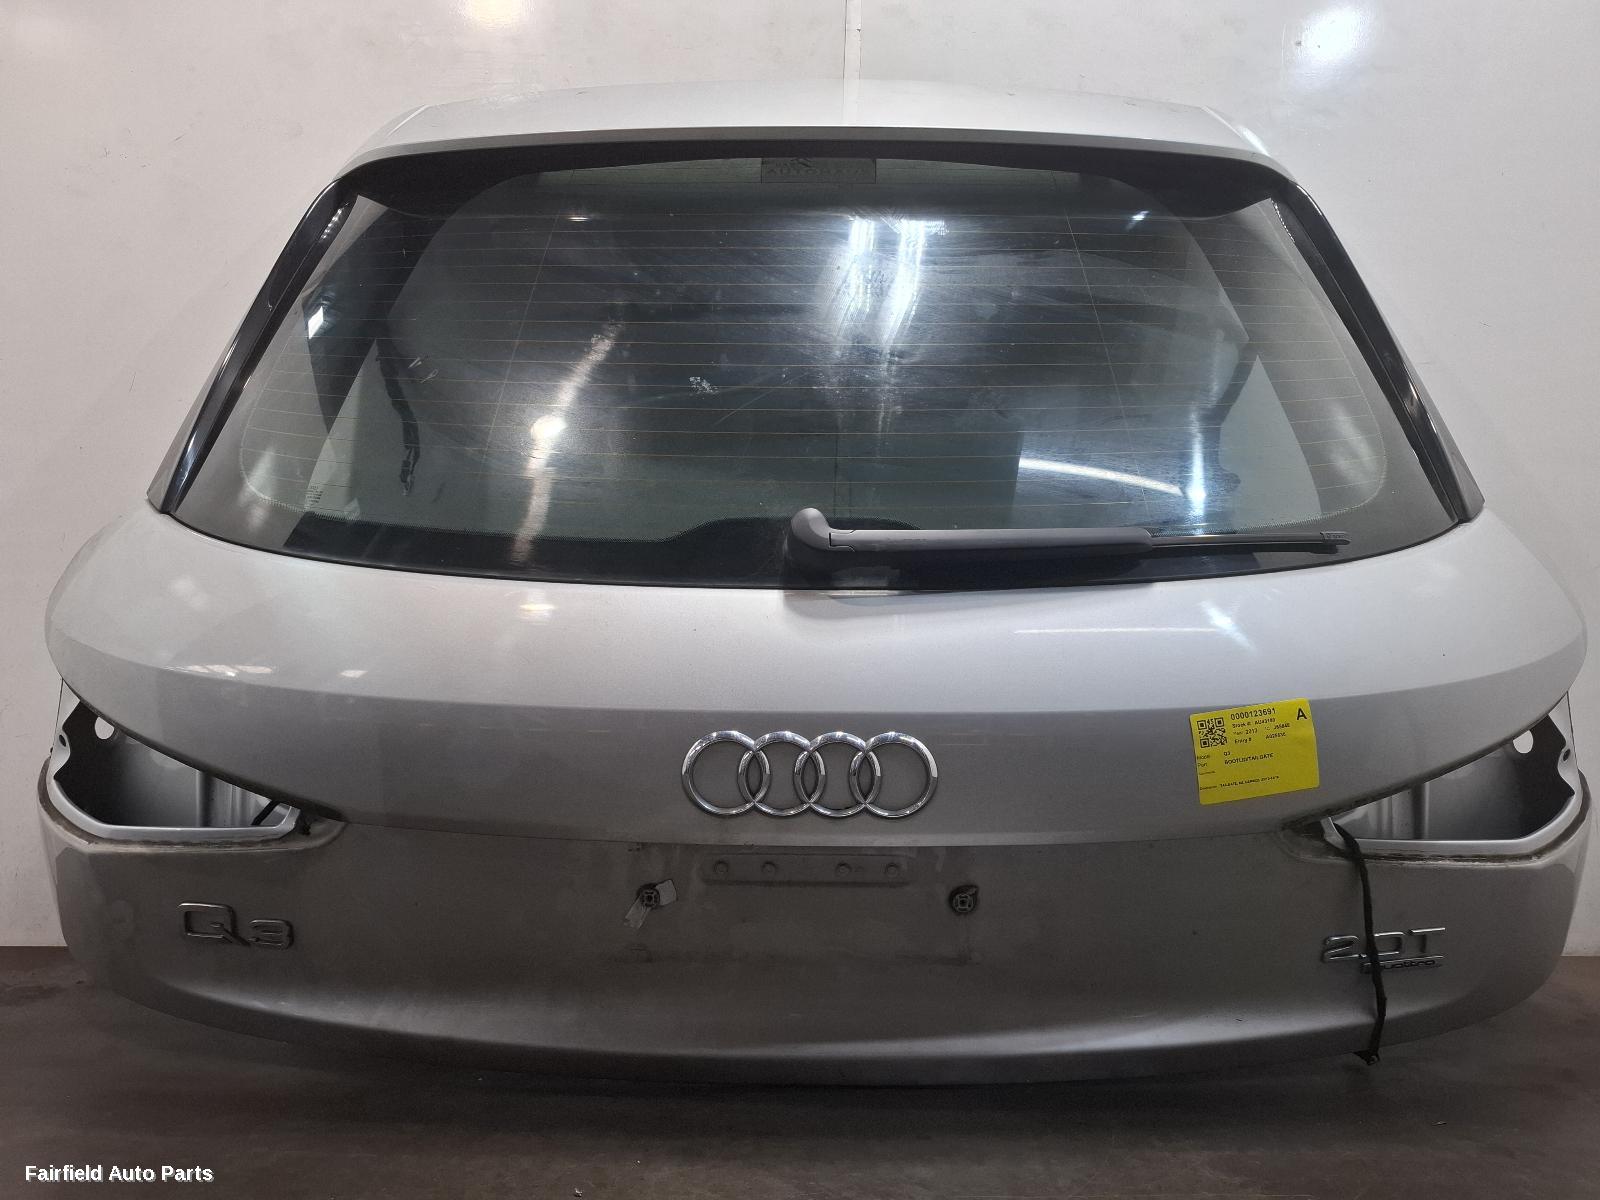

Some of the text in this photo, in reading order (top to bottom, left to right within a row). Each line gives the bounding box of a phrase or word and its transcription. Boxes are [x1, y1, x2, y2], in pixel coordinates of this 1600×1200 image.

[1231, 707, 1276, 720] 0000123691
[1296, 708, 1308, 720] A
[176, 902, 294, 950] Q3
